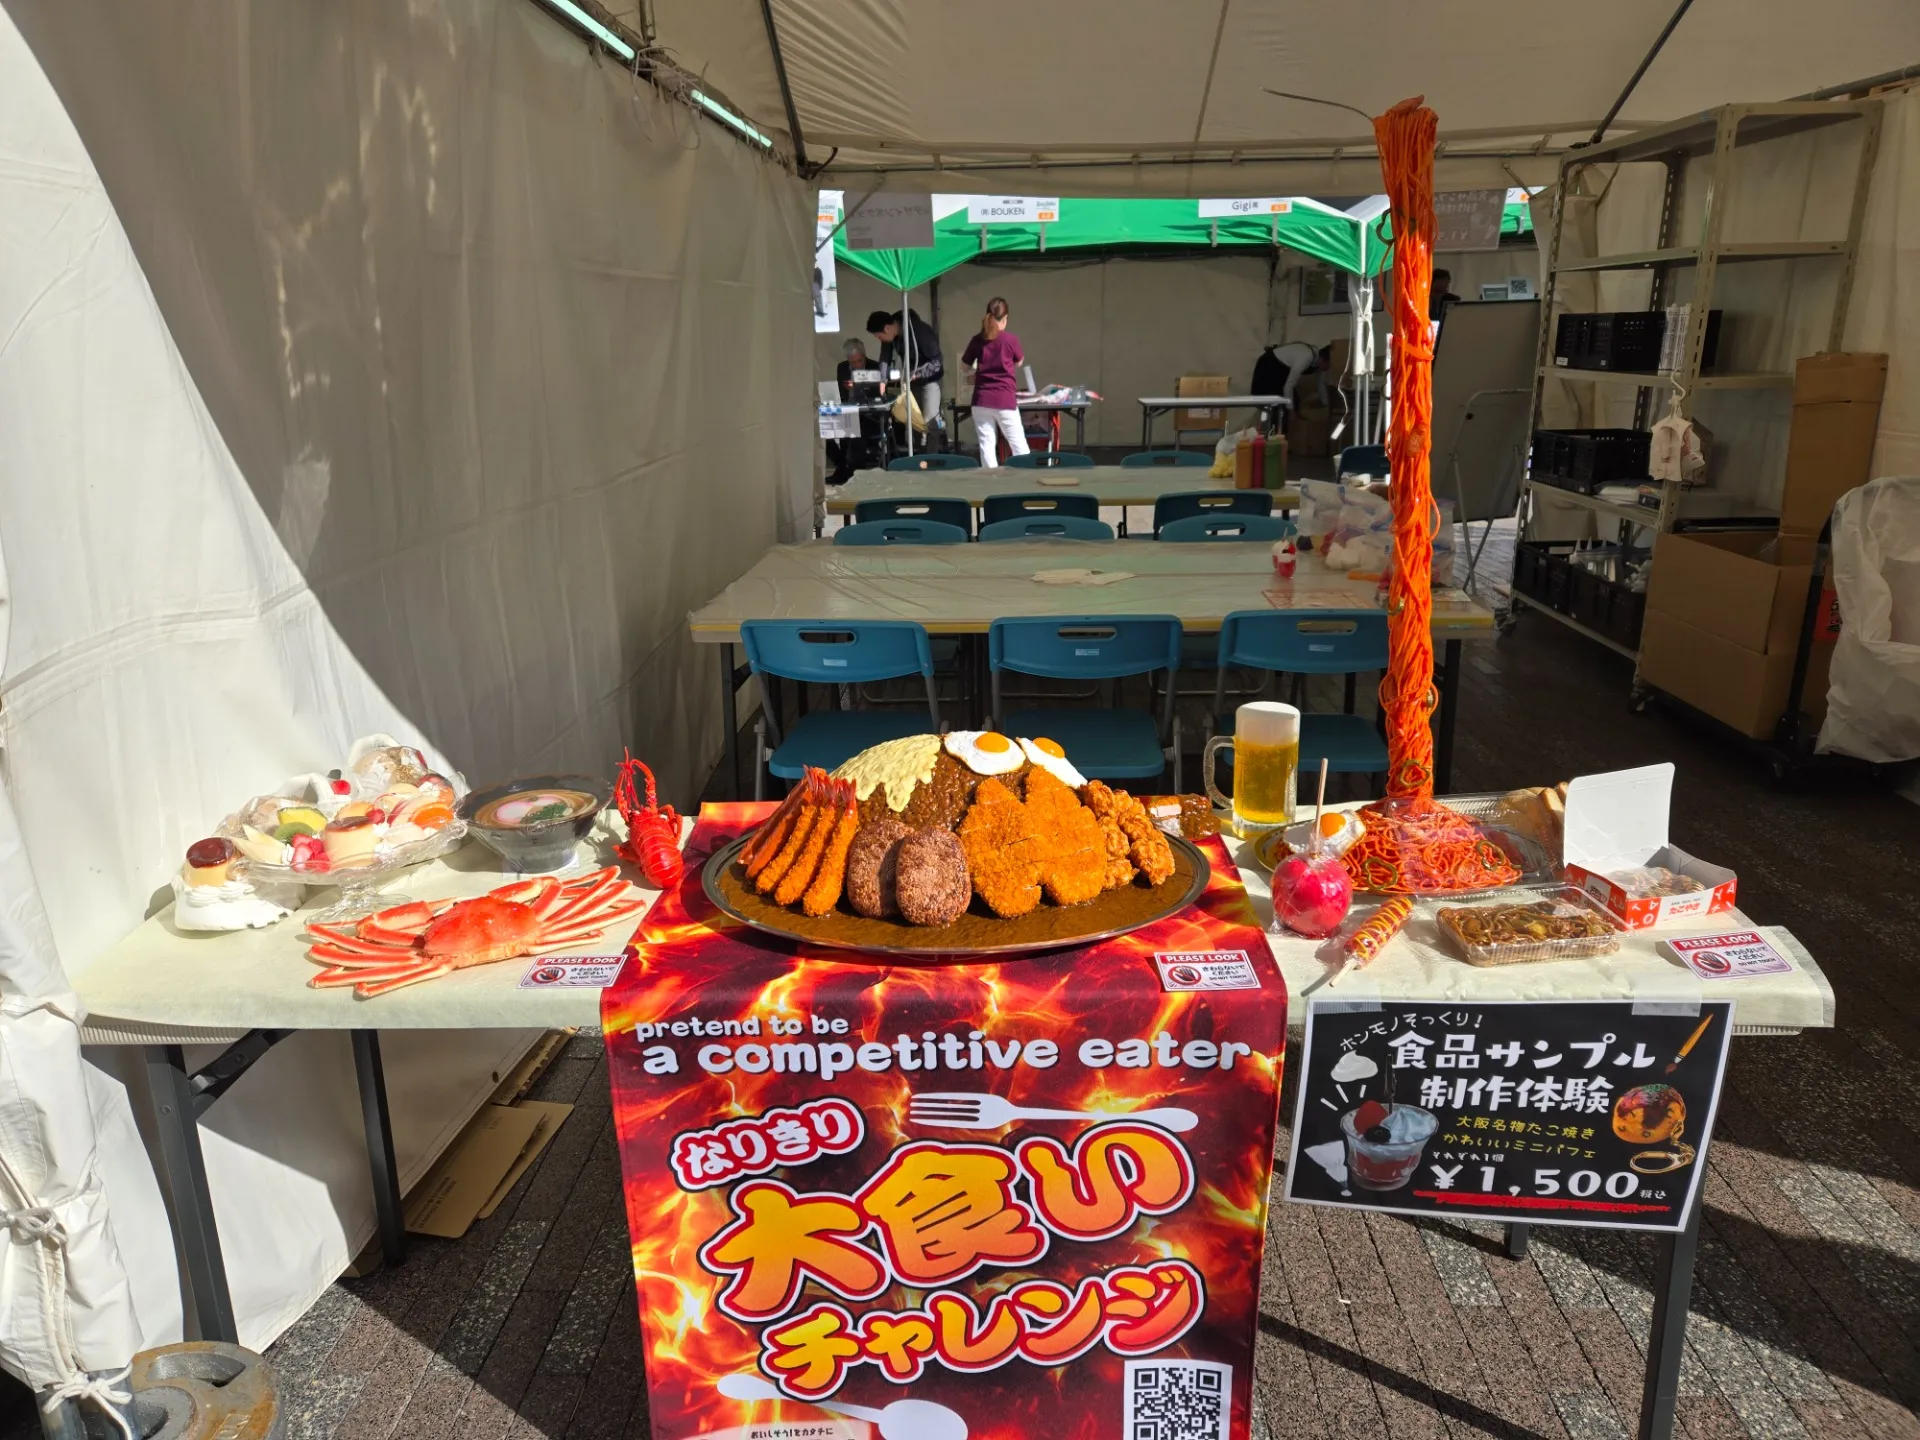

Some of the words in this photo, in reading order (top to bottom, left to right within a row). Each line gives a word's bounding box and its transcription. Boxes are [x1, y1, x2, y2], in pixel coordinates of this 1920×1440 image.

[991, 207, 1025, 216] BOUKEN
[1682, 938, 1721, 949] PLEASE
[1723, 934, 1756, 945] LOOK
[1723, 946, 1769, 957] さわらないで
[543, 957, 584, 965] PLEASE
[586, 956, 618, 964] LOOK
[1166, 955, 1206, 963] PLEASE
[1208, 954, 1240, 962] LOOK
[1737, 953, 1766, 961] ください
[635, 1016, 762, 1044] pretend
[769, 1016, 804, 1036] to
[811, 1014, 849, 1035] be
[1340, 1012, 1484, 1052] ホンモノそっくり!
[642, 1043, 679, 1076] a
[697, 1030, 1060, 1081] competitive
[1078, 1033, 1253, 1072] eater
[1386, 1032, 1657, 1071] 食品サンプル
[1418, 1075, 1615, 1115] 制作体験
[1456, 1115, 1597, 1140] 大阪名物たこ焼き
[682, 1106, 858, 1180] なりきり
[1442, 1132, 1597, 1159] かわいいミニパフェ
[706, 1127, 1190, 1315] 大食い
[773, 1265, 1199, 1395] チャレンジ
[750, 1427, 834, 1439] おいしそう!をカタチに
